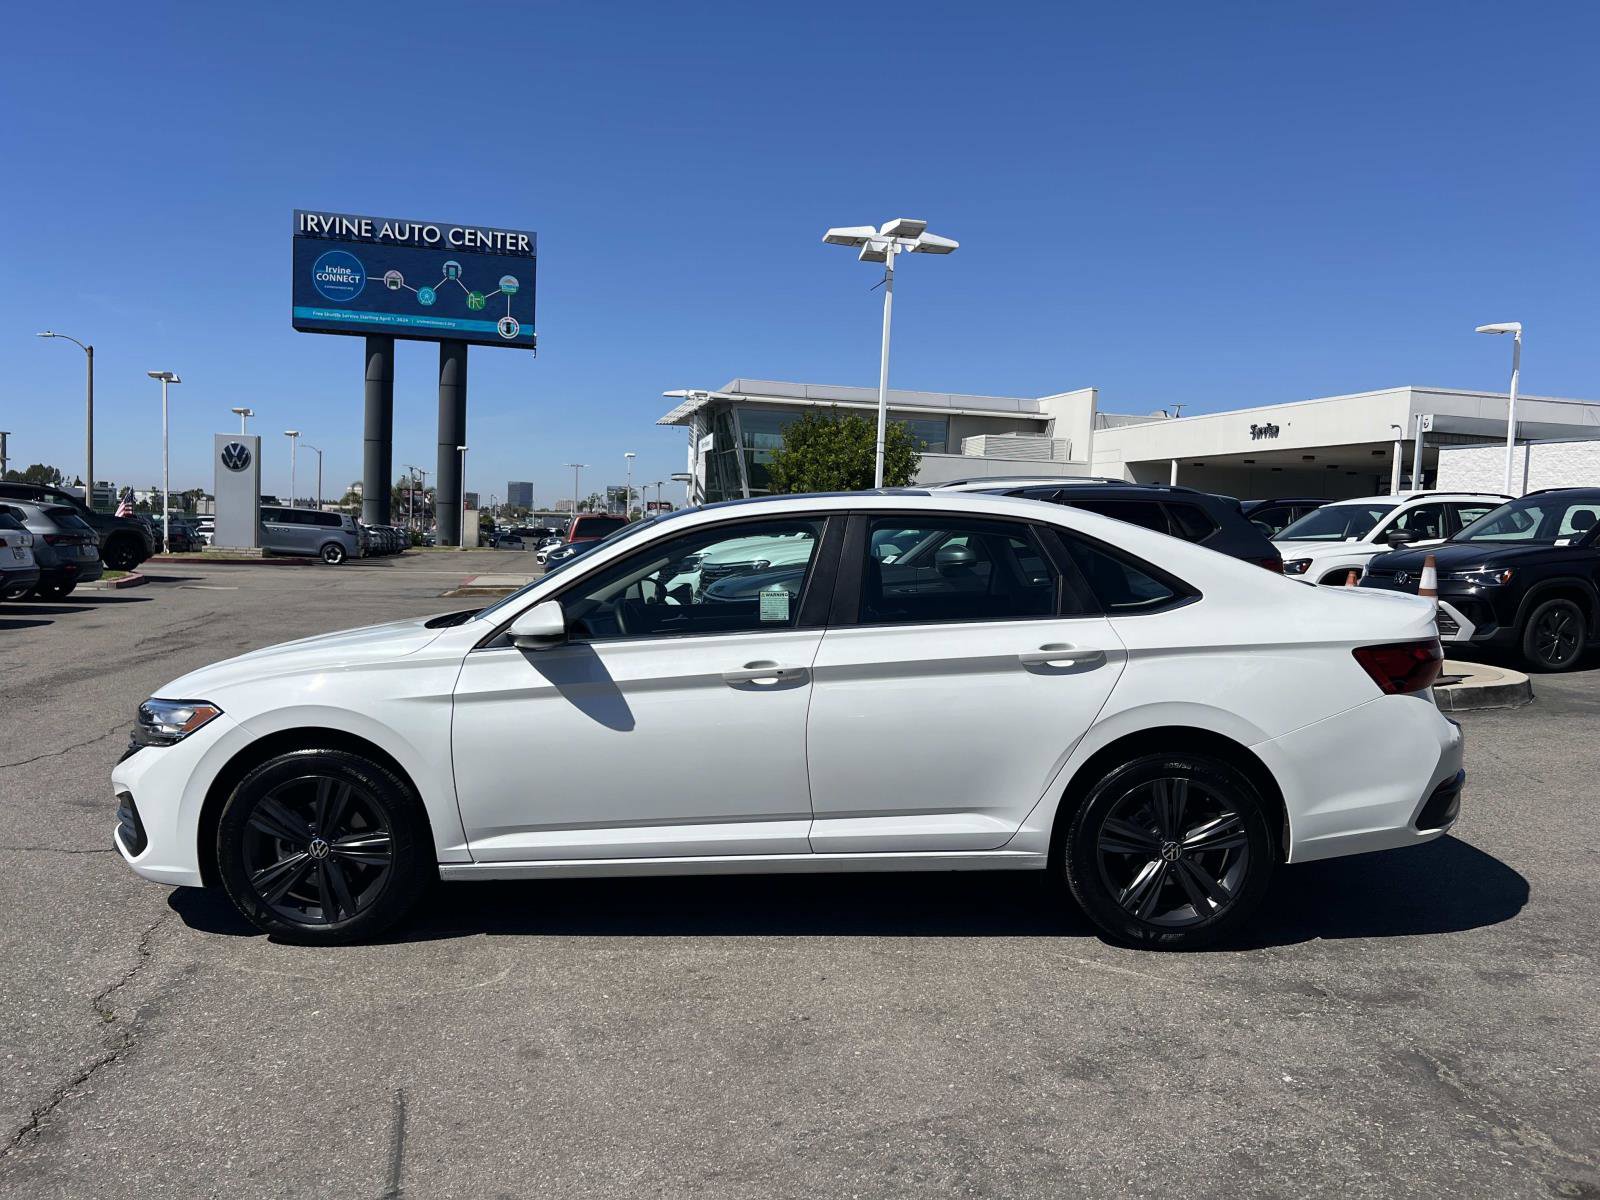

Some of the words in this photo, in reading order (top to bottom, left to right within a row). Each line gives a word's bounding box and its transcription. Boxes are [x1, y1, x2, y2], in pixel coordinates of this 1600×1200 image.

[300, 213, 372, 237] IRVINE
[379, 222, 441, 243] AUTO
[448, 227, 529, 251] CENTER
[325, 265, 352, 275] Irvine
[316, 273, 361, 284] CONNECT
